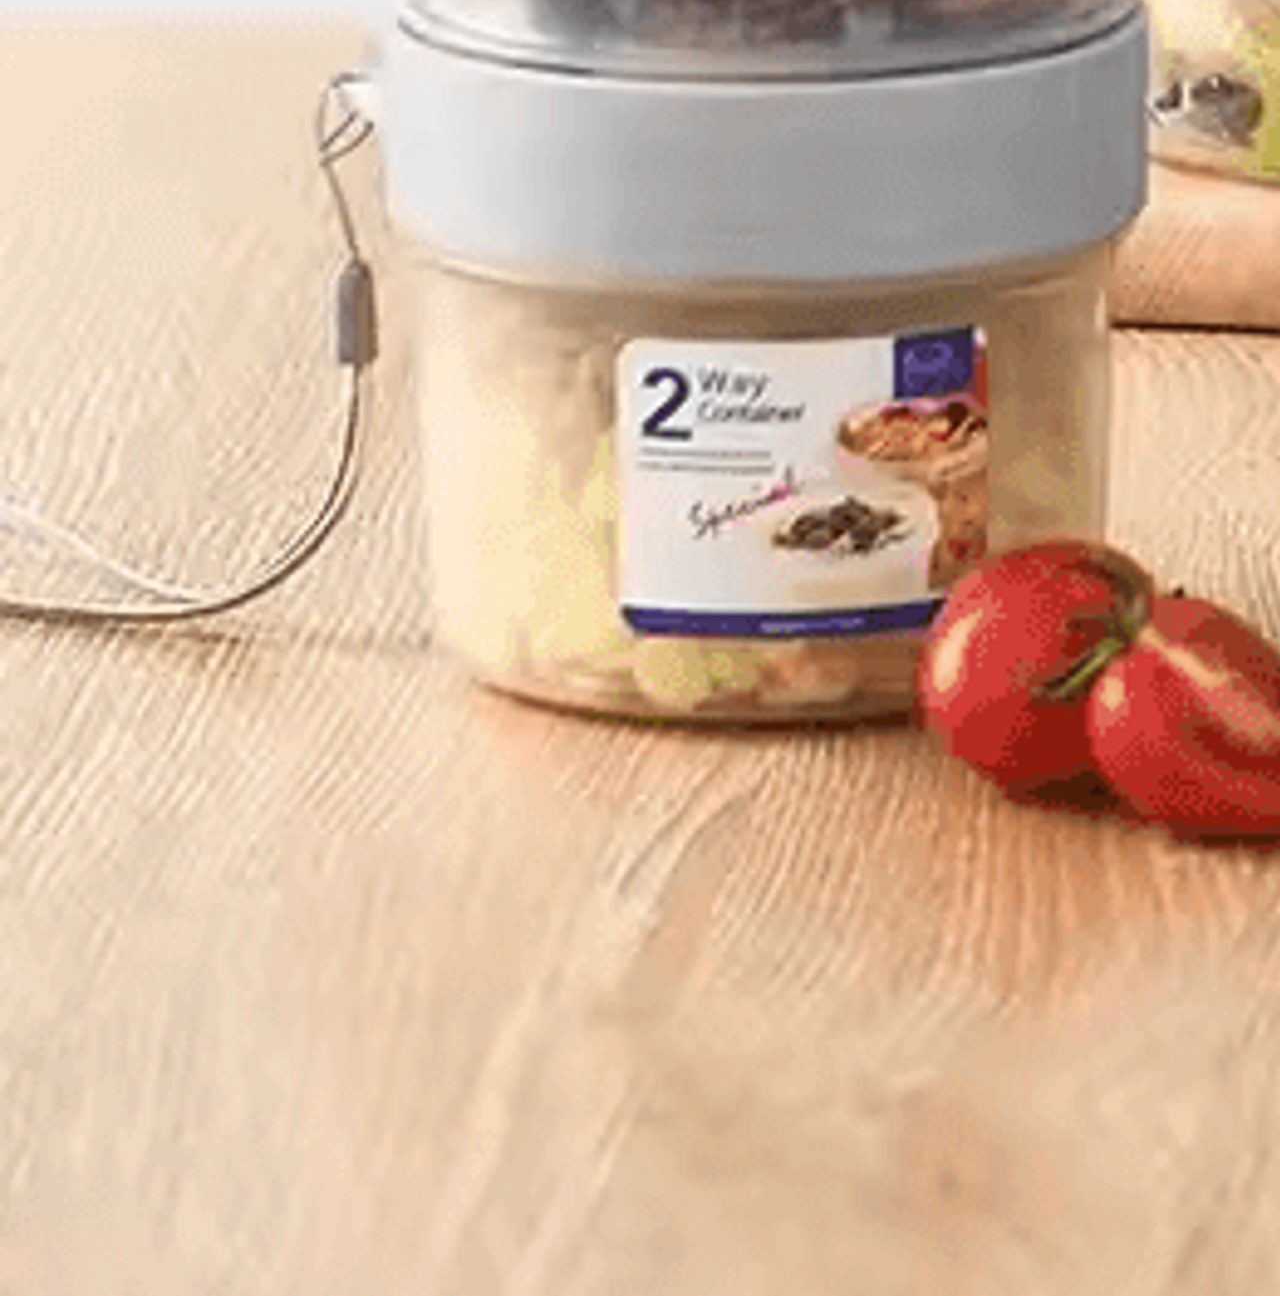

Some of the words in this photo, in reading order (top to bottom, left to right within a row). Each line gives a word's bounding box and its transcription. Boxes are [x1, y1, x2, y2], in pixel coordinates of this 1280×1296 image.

[641, 368, 692, 441] 2
[700, 368, 771, 398] Way
[698, 401, 805, 423] Container
